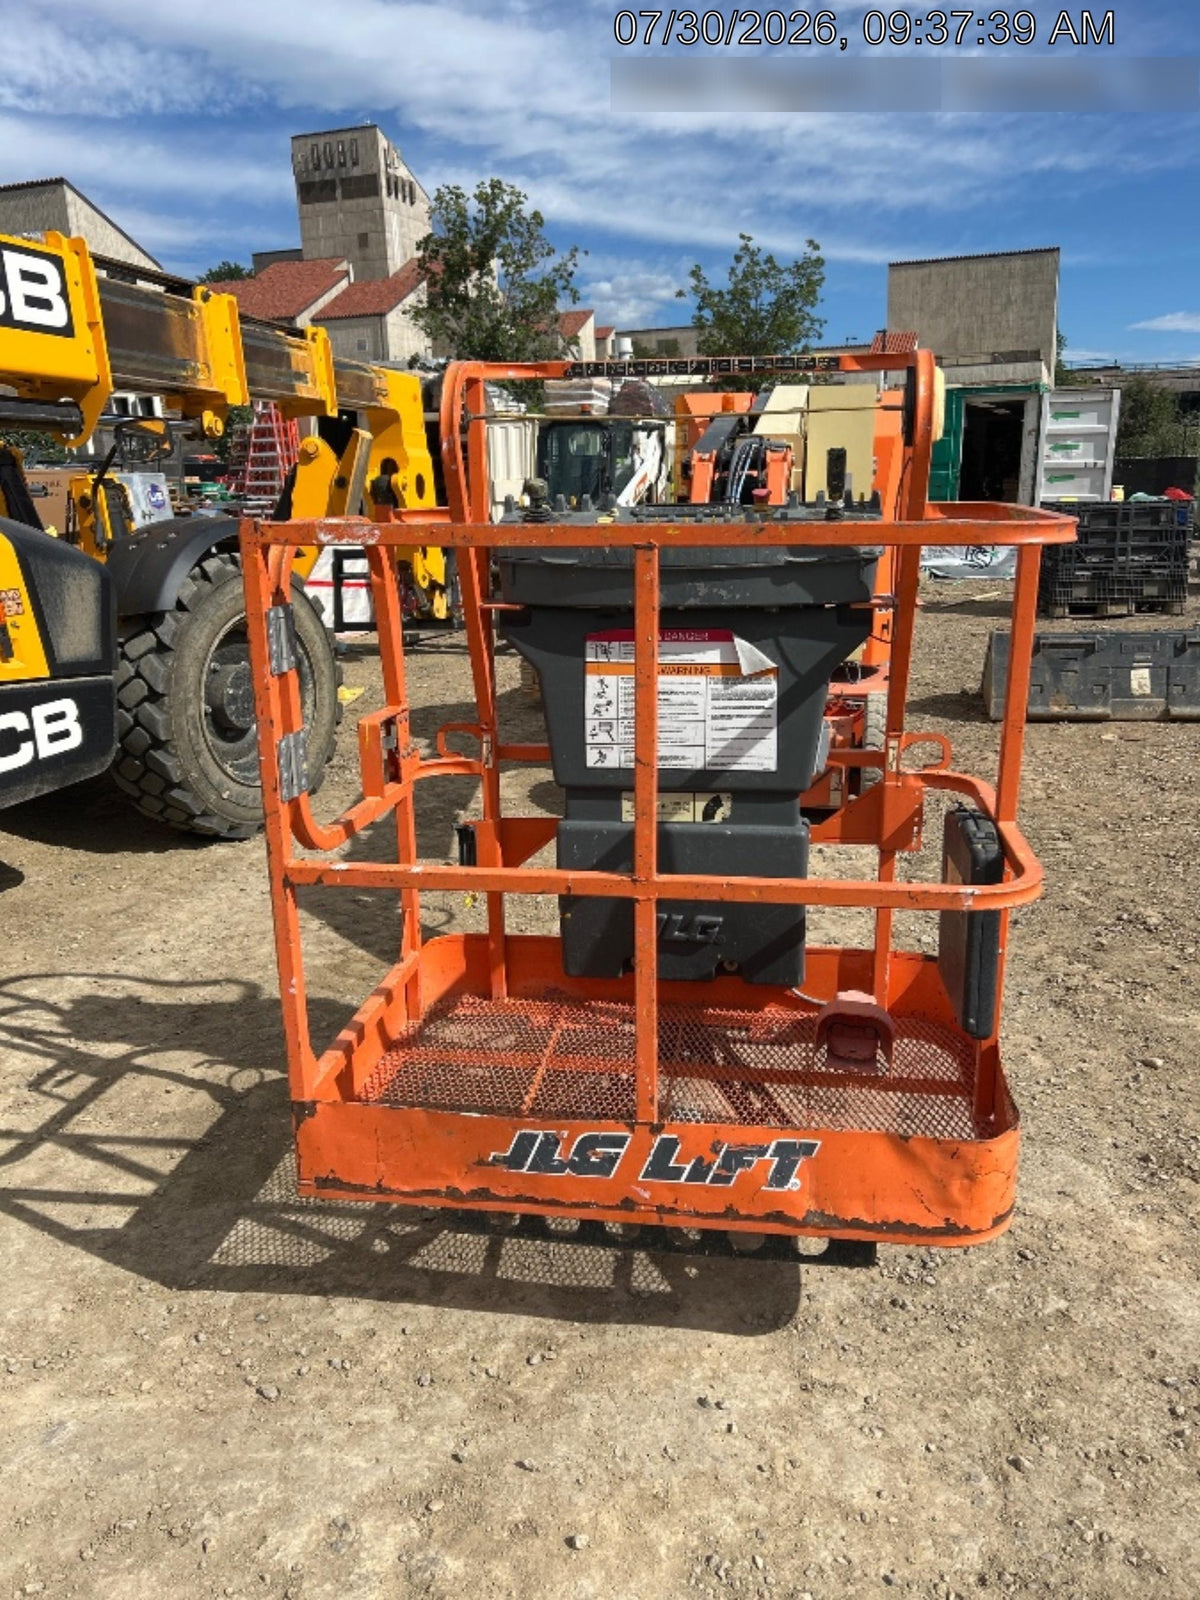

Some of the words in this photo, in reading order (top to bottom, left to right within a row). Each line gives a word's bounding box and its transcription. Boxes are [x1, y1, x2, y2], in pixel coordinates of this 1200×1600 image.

[0, 249, 68, 328] B
[664, 631, 709, 641] DANGER
[660, 665, 712, 676] WARNING
[489, 1129, 633, 1179] JLG
